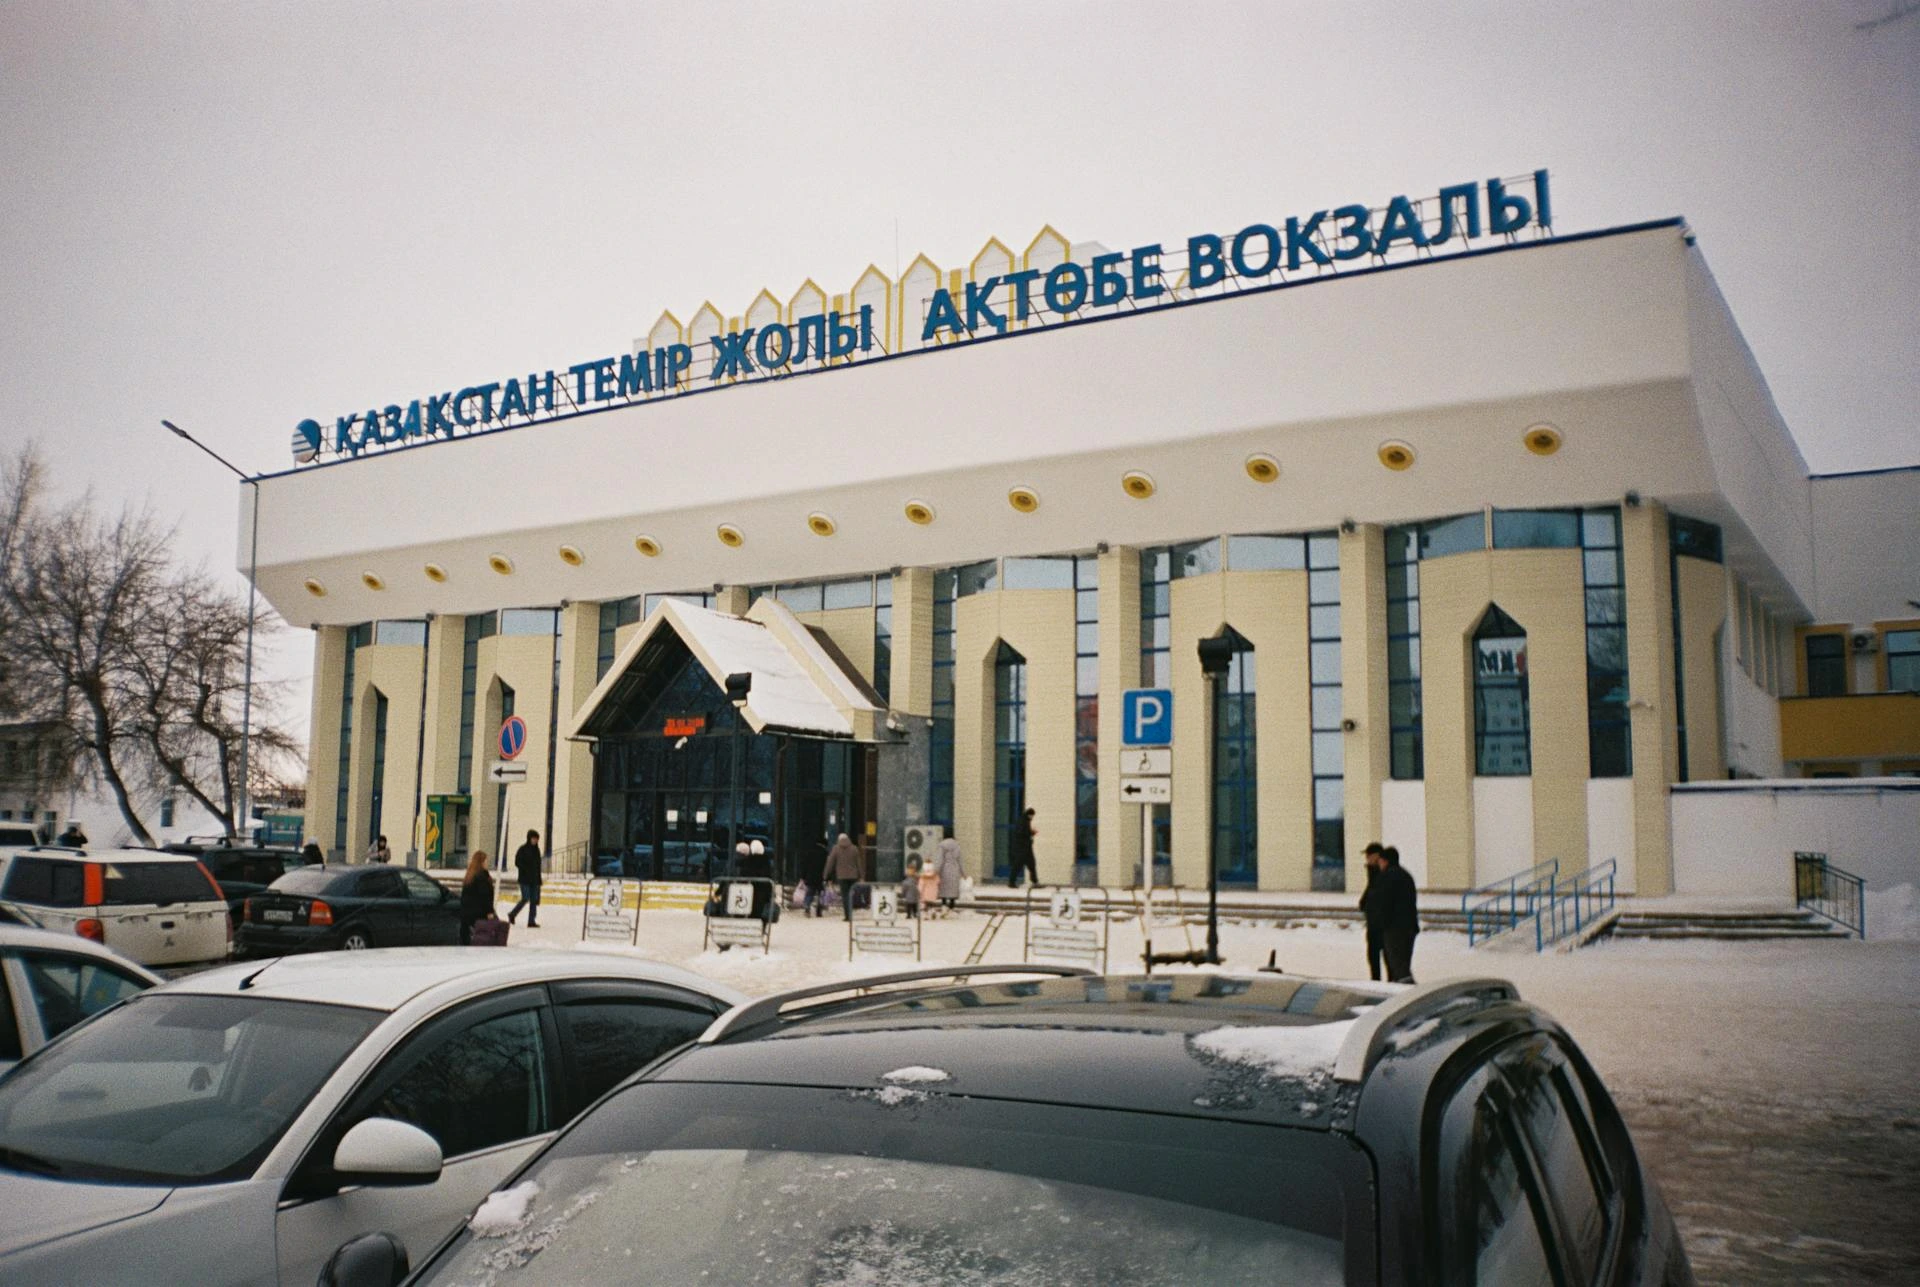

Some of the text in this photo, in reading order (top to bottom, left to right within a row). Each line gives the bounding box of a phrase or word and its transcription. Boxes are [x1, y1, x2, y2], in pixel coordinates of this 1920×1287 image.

[922, 169, 1551, 341] АҚТӨБЕ ВОКЗАЛЫ
[335, 304, 872, 458] ҚАЗАҚСТАН ТЕМІР ЖОЛЫ
[1135, 696, 1163, 739] P
